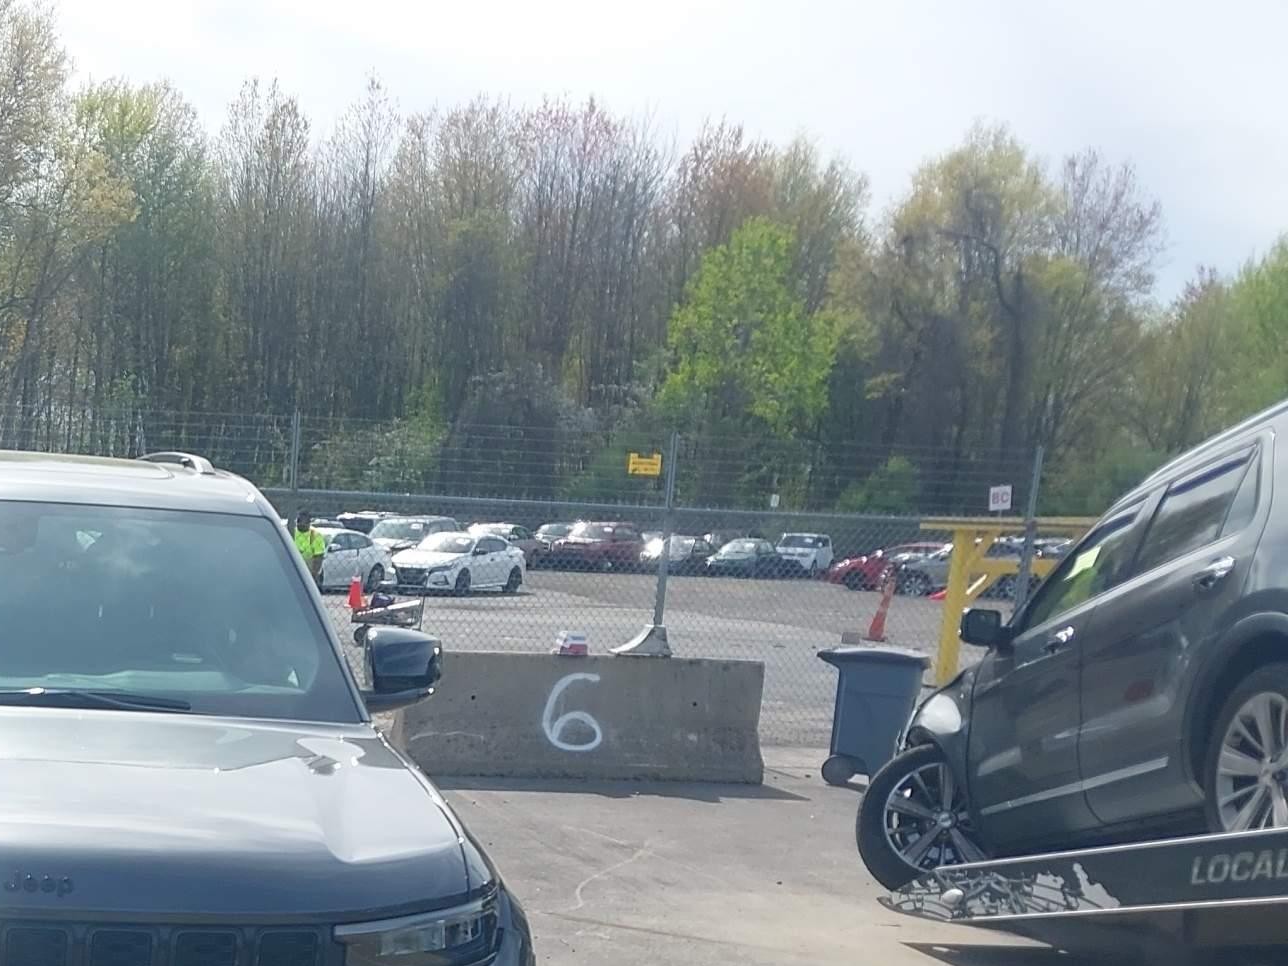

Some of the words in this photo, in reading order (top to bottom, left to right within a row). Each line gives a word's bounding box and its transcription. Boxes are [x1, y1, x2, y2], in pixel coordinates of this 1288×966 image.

[542, 672, 602, 751] 6
[3, 869, 74, 898] Jeep
[1190, 847, 1288, 885] LOCAL
